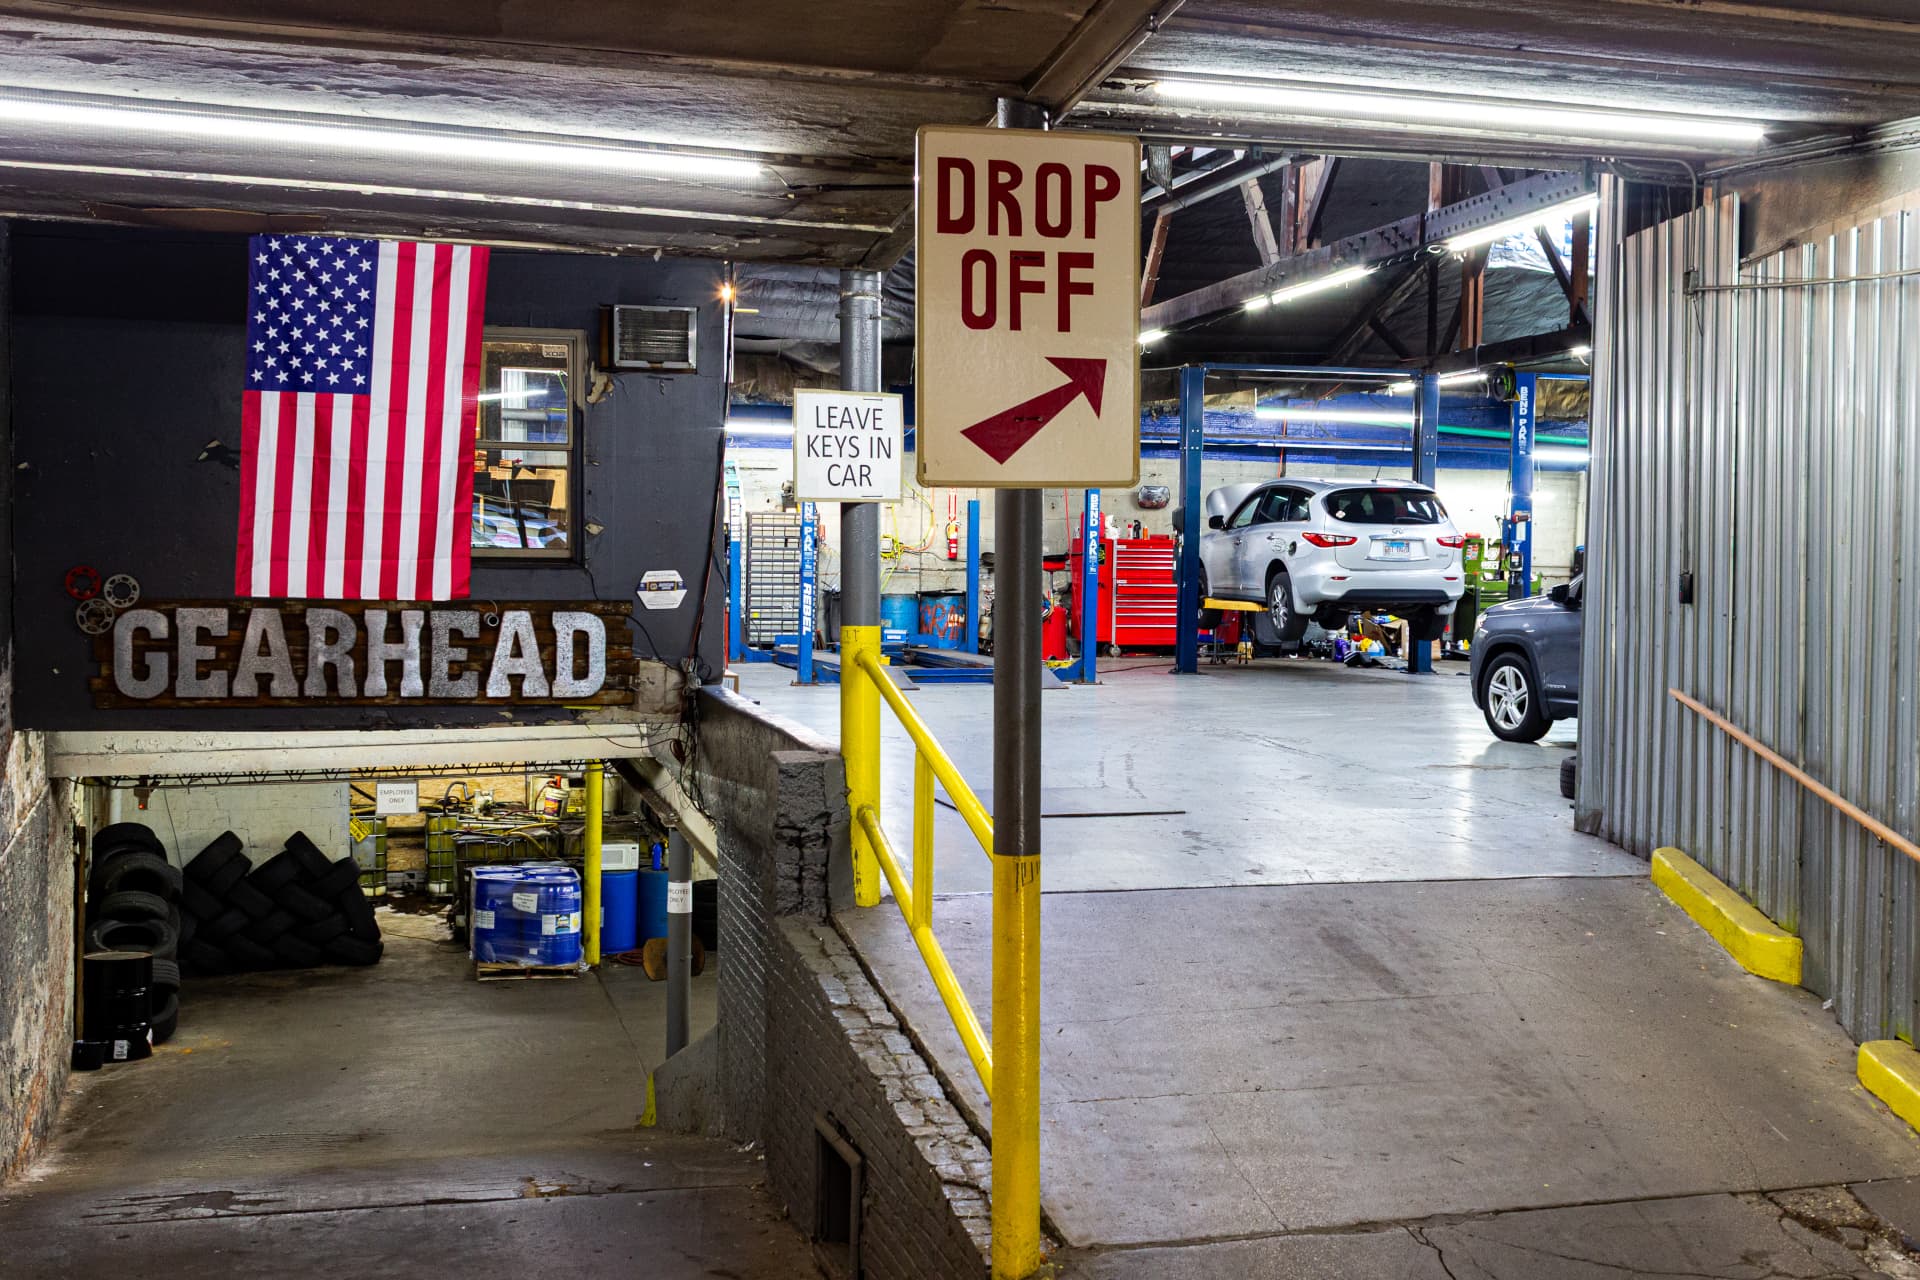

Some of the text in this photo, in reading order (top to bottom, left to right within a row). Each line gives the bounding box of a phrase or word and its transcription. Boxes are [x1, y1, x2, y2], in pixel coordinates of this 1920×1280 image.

[936, 156, 1121, 240] DROP
[960, 248, 1095, 334] OFF
[815, 405, 884, 431] LEAVE
[806, 435, 892, 460] KEYS IN
[827, 463, 873, 488] CAR
[1090, 494, 1099, 527] BEND
[802, 583, 812, 636] REBEL
[112, 606, 608, 700] GEARHEAD
